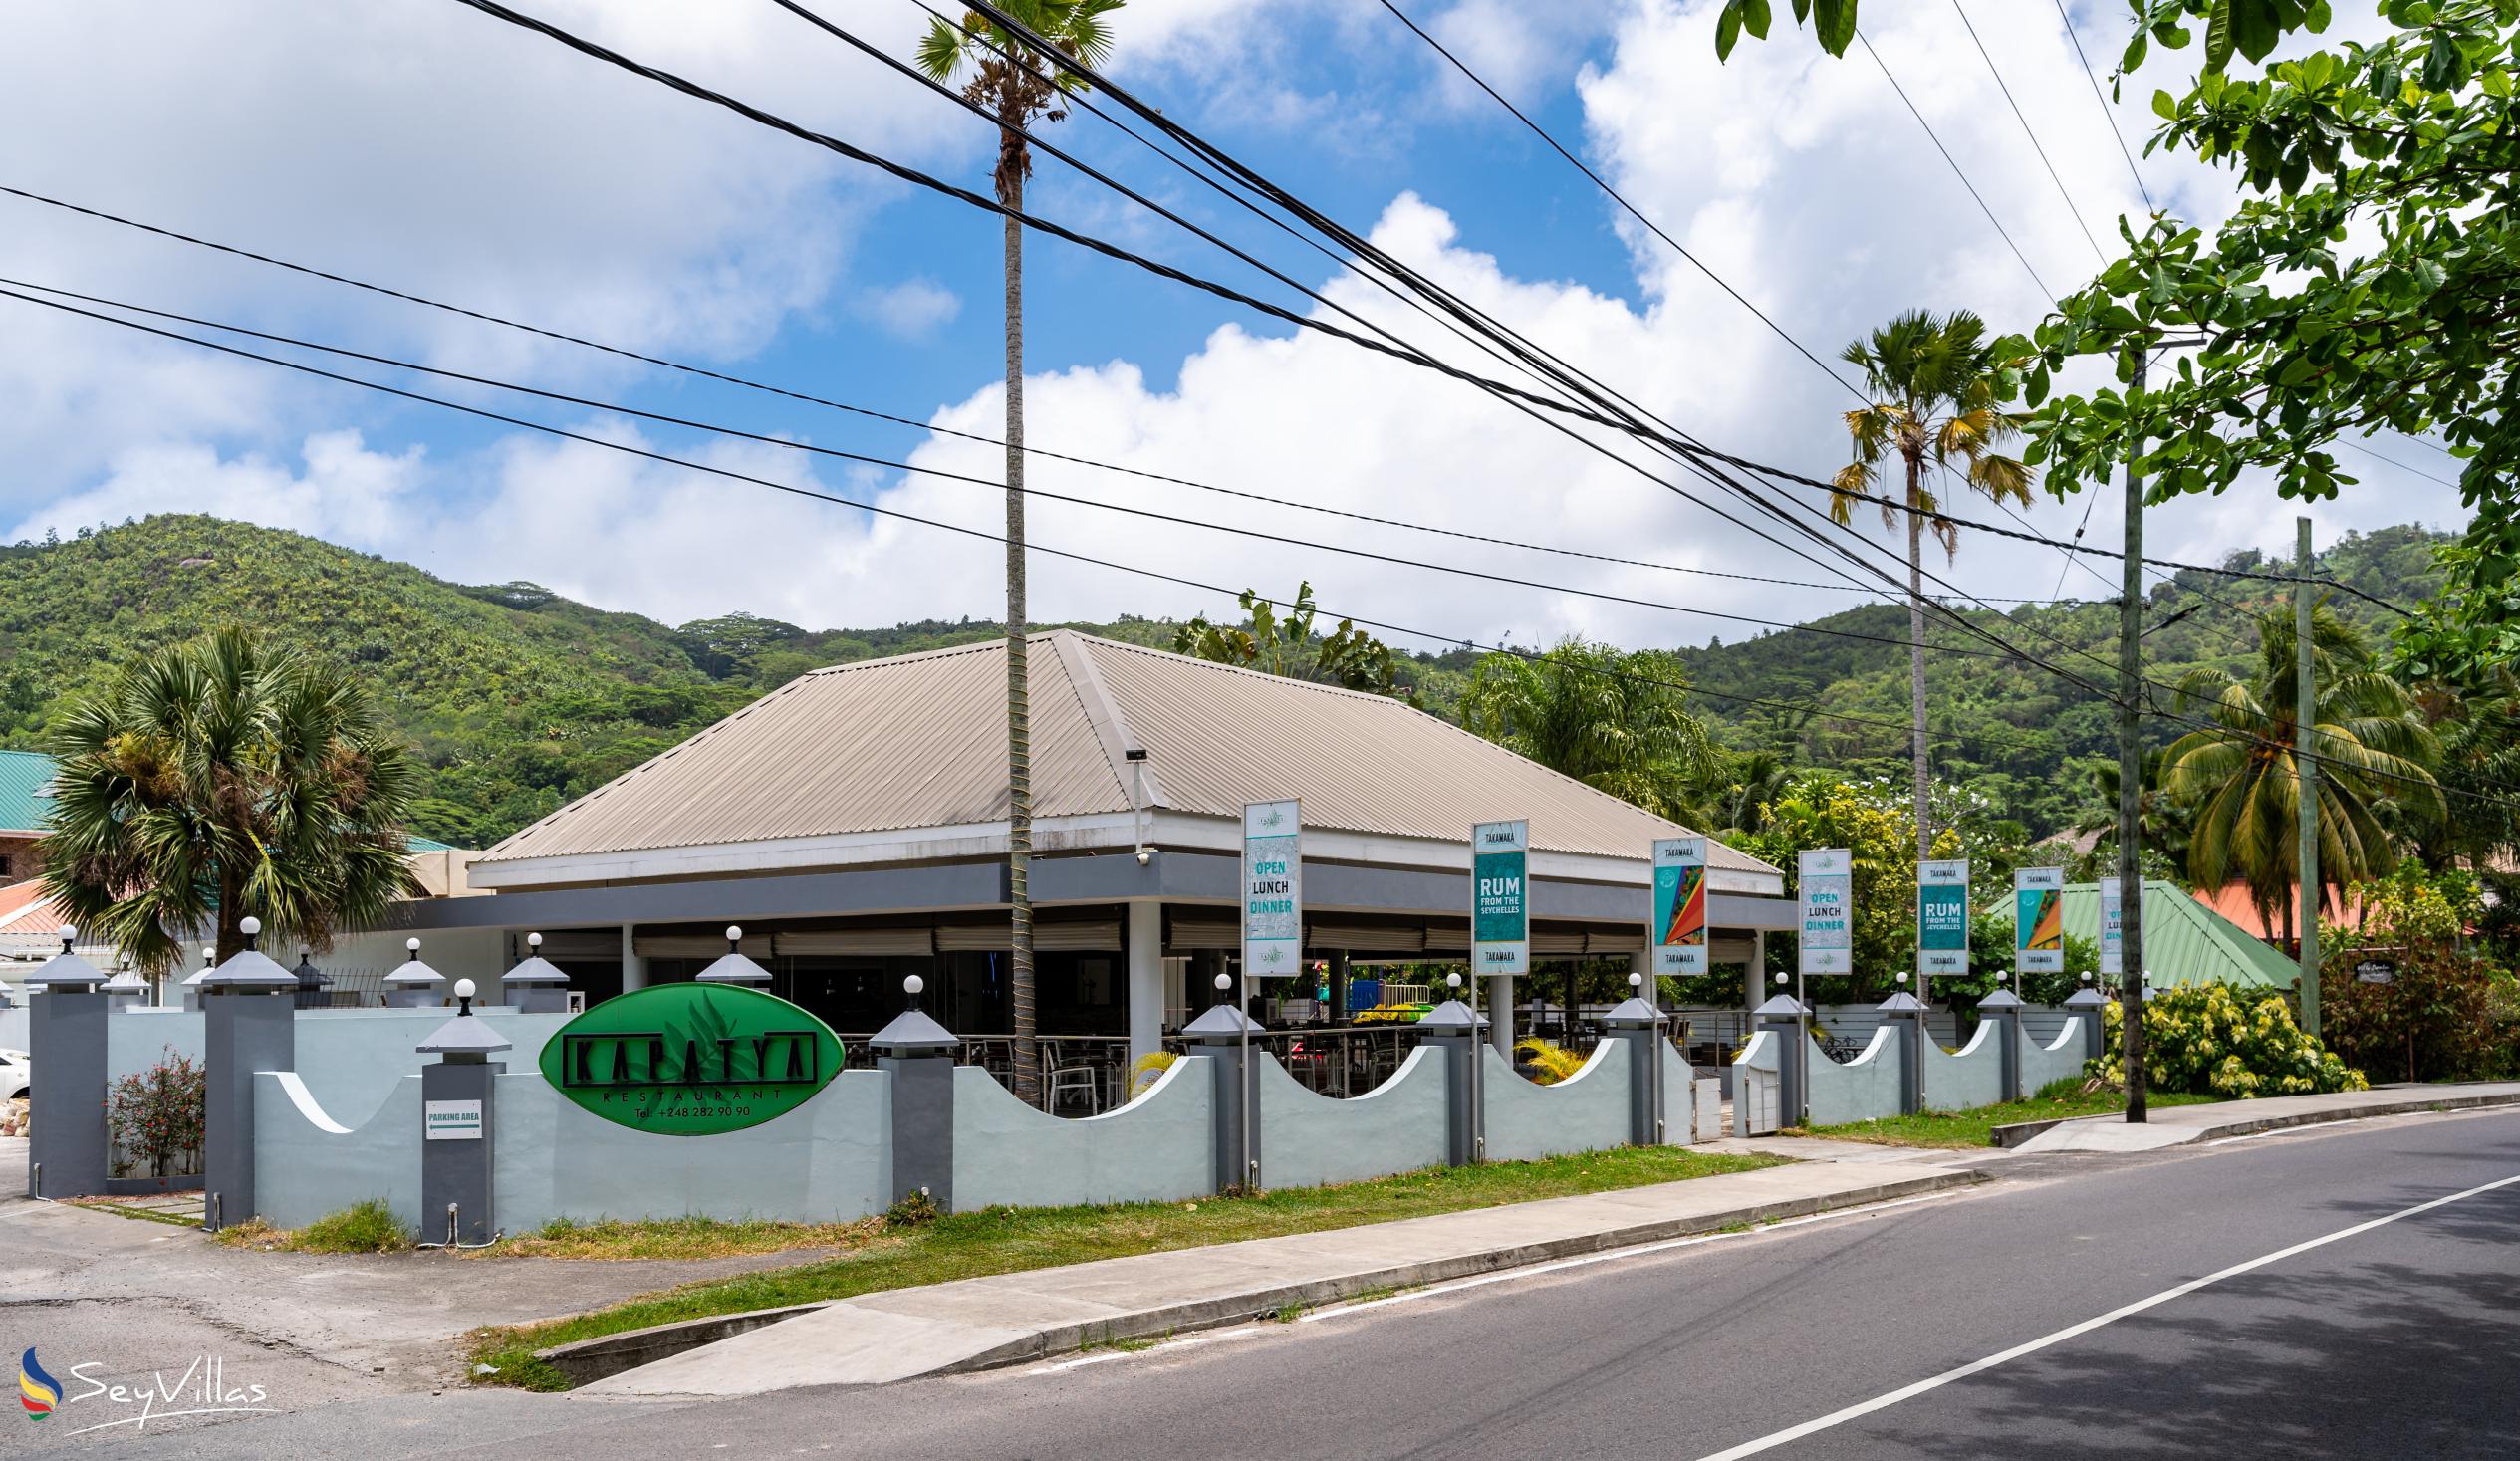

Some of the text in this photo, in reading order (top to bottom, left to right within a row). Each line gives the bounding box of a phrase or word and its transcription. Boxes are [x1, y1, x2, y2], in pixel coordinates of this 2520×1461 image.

[1485, 832, 1515, 844] TAKAMAKA
[1665, 848, 1694, 857] TAKAMAKA
[1256, 861, 1286, 875] OPEN
[1253, 880, 1289, 895] LUNCH
[1480, 876, 1520, 896] RUM
[1480, 896, 1520, 906] FROM THE
[1811, 893, 1839, 903] OPEN
[1250, 899, 1293, 914] DINNER
[1480, 906, 1520, 915] SEYCHELLES
[1809, 907, 1842, 917] LUNCH
[1925, 902, 1961, 917] RUM
[1806, 920, 1845, 930] DINNER
[1485, 951, 1515, 962] TAKAMAKA
[1666, 954, 1695, 964] TAKAMAKA
[576, 1037, 804, 1082] KAPATYA
[602, 1089, 782, 1103] RESTAURANT
[428, 1111, 480, 1122] PARKING AREA
[634, 1105, 750, 1118] Tel: +248 282 90 90
